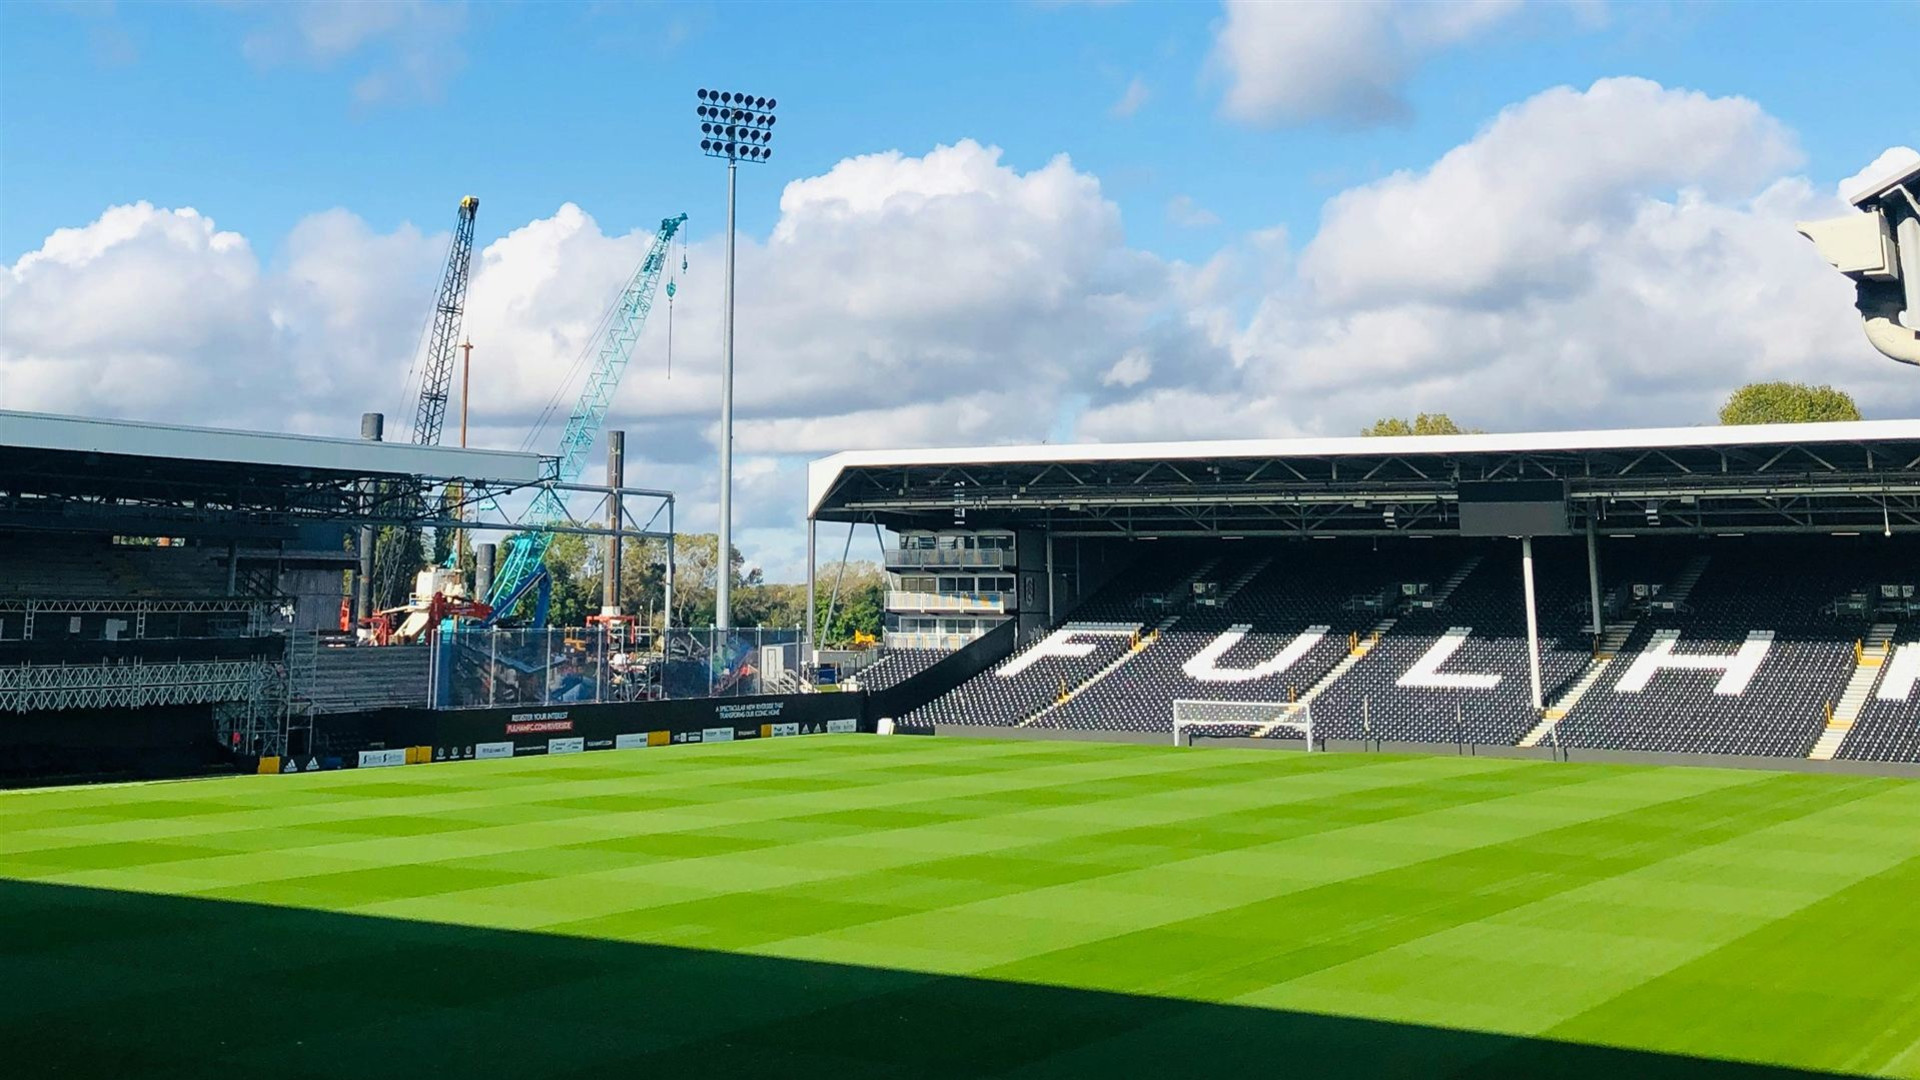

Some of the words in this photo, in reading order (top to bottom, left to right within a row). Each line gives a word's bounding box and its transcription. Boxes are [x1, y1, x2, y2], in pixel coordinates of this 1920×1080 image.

[511, 713, 533, 722] REGISTER
[534, 712, 547, 721] YOUR
[547, 711, 569, 720] INTEREST
